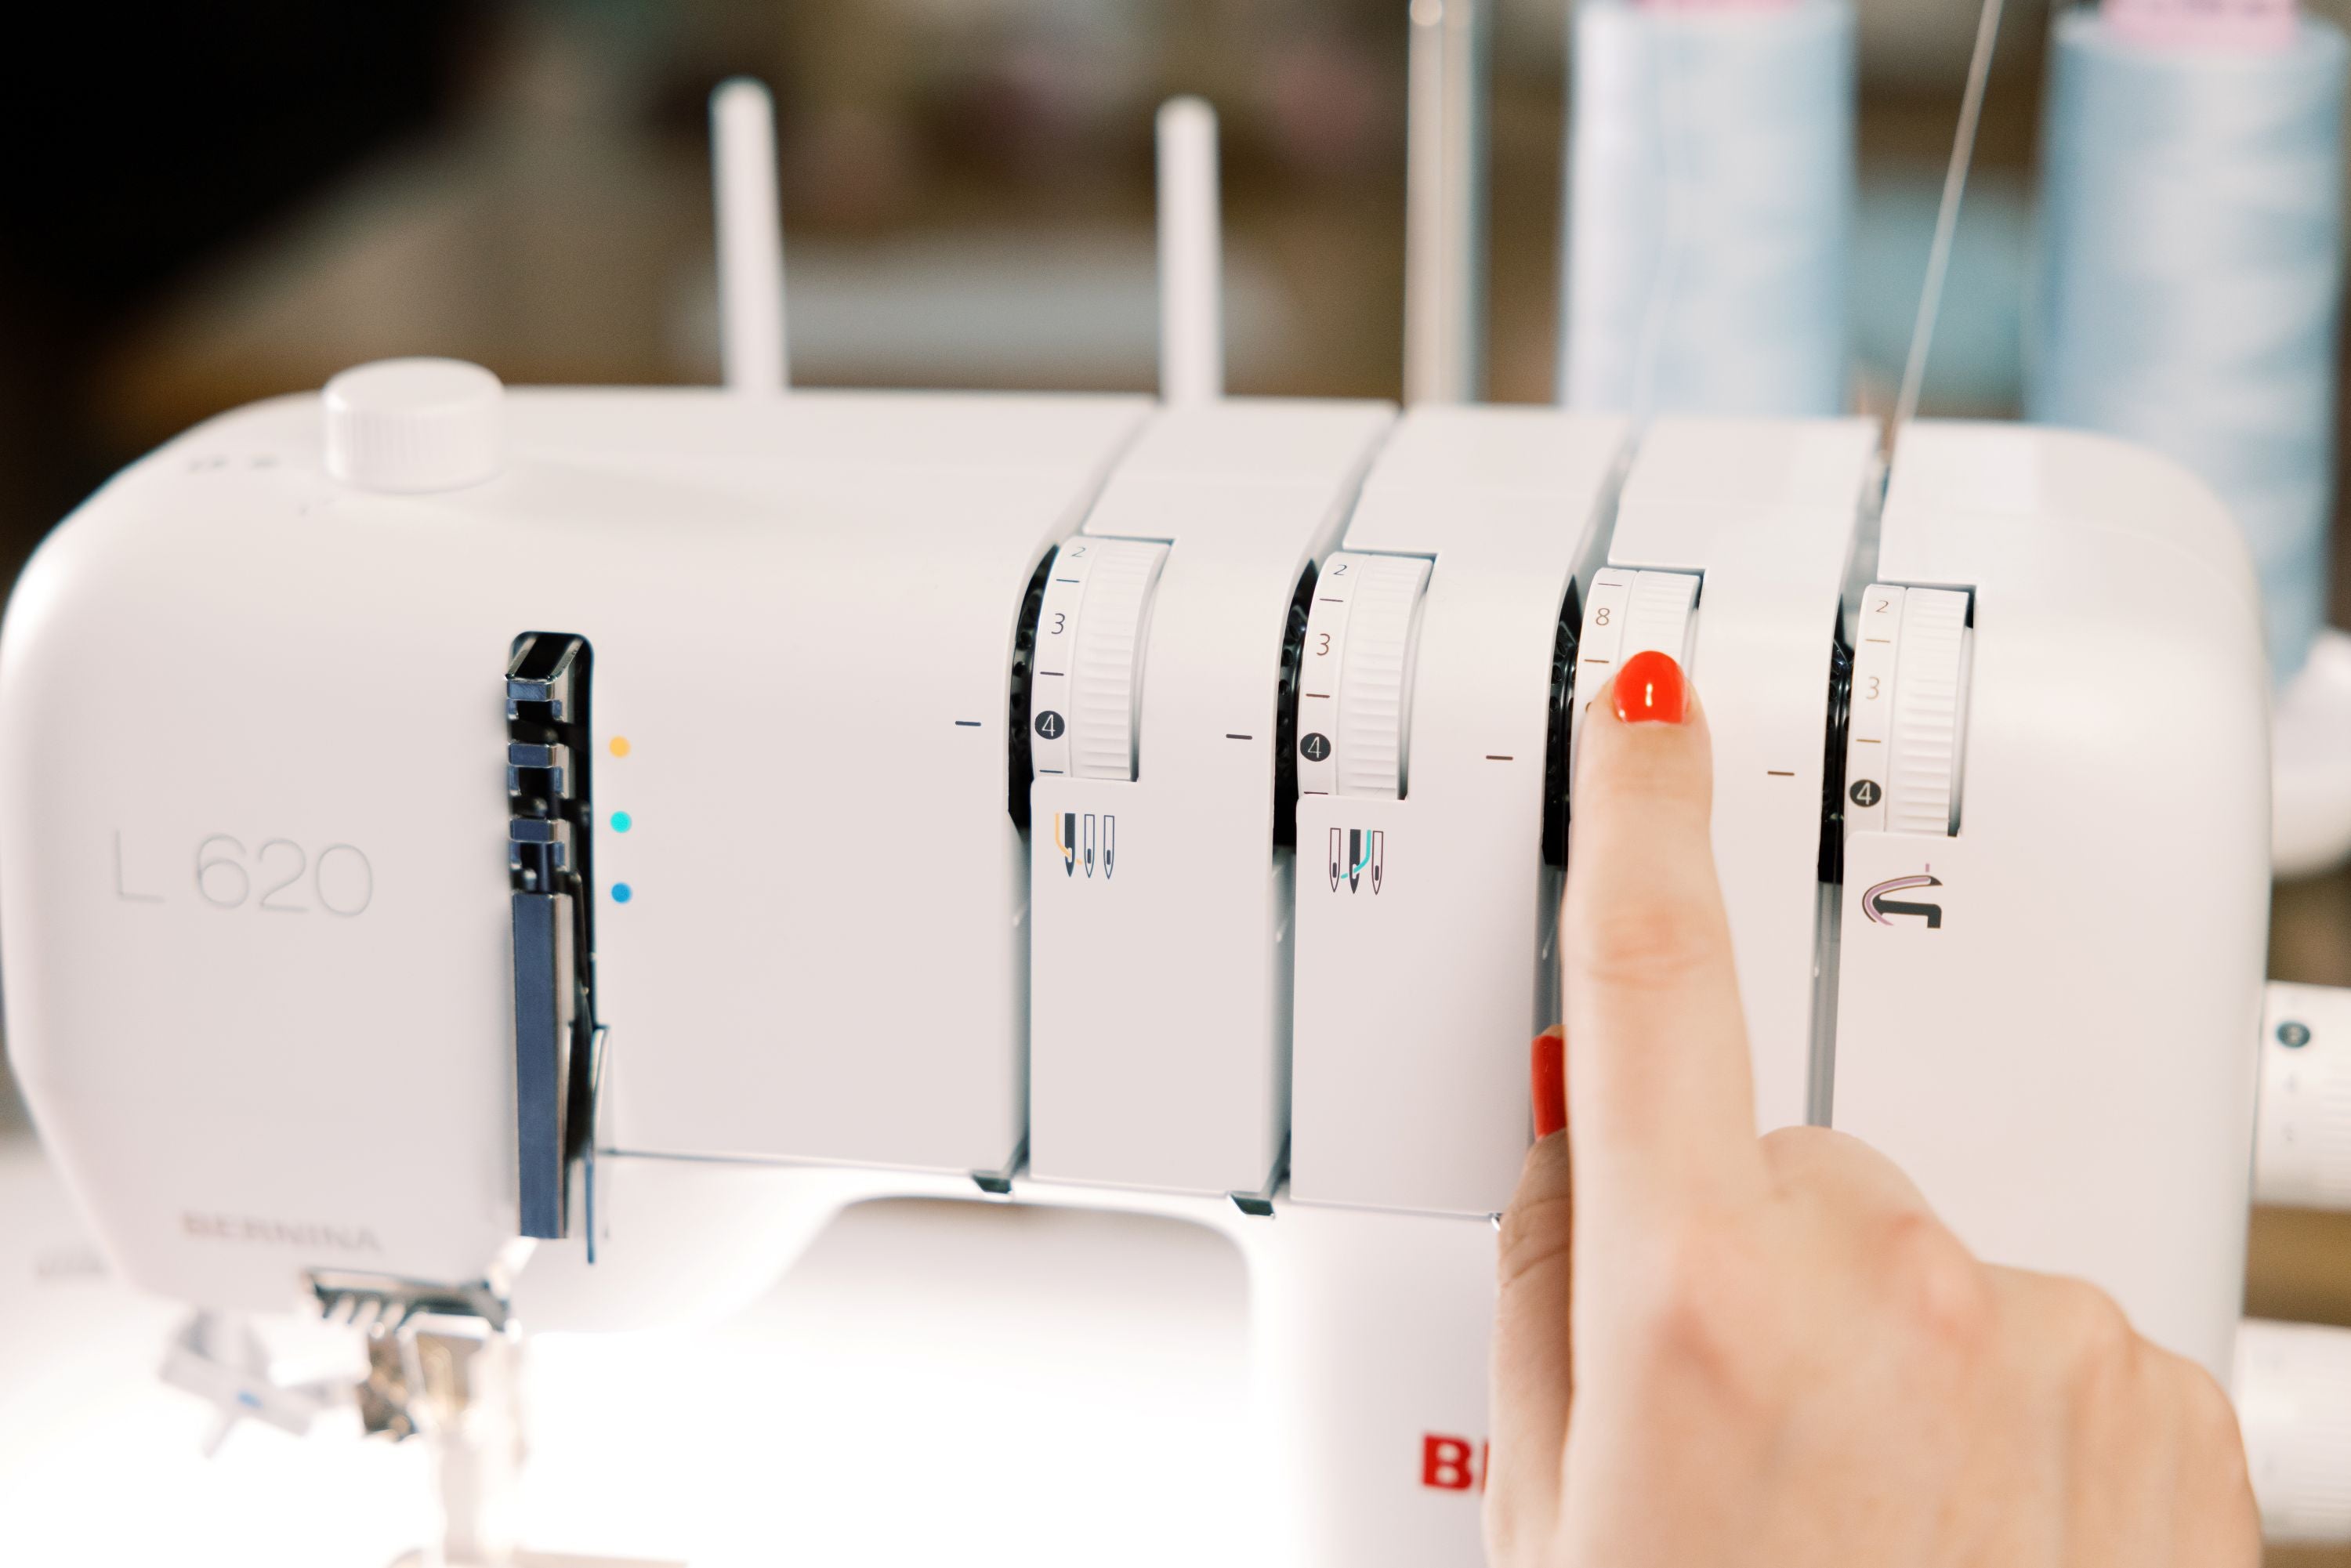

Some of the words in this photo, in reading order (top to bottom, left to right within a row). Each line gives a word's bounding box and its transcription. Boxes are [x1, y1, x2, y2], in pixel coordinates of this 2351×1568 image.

[1070, 546, 1086, 558] 2
[1333, 563, 1348, 576] 2
[1595, 607, 1610, 626] 8
[1875, 599, 1889, 614] 2
[1050, 613, 1067, 635] 3
[1316, 632, 1331, 656] 3
[1865, 675, 1880, 700] 3
[1856, 781, 1872, 806] 4
[114, 828, 166, 904] L
[195, 832, 374, 918] 620
[1422, 1434, 1489, 1494] B
